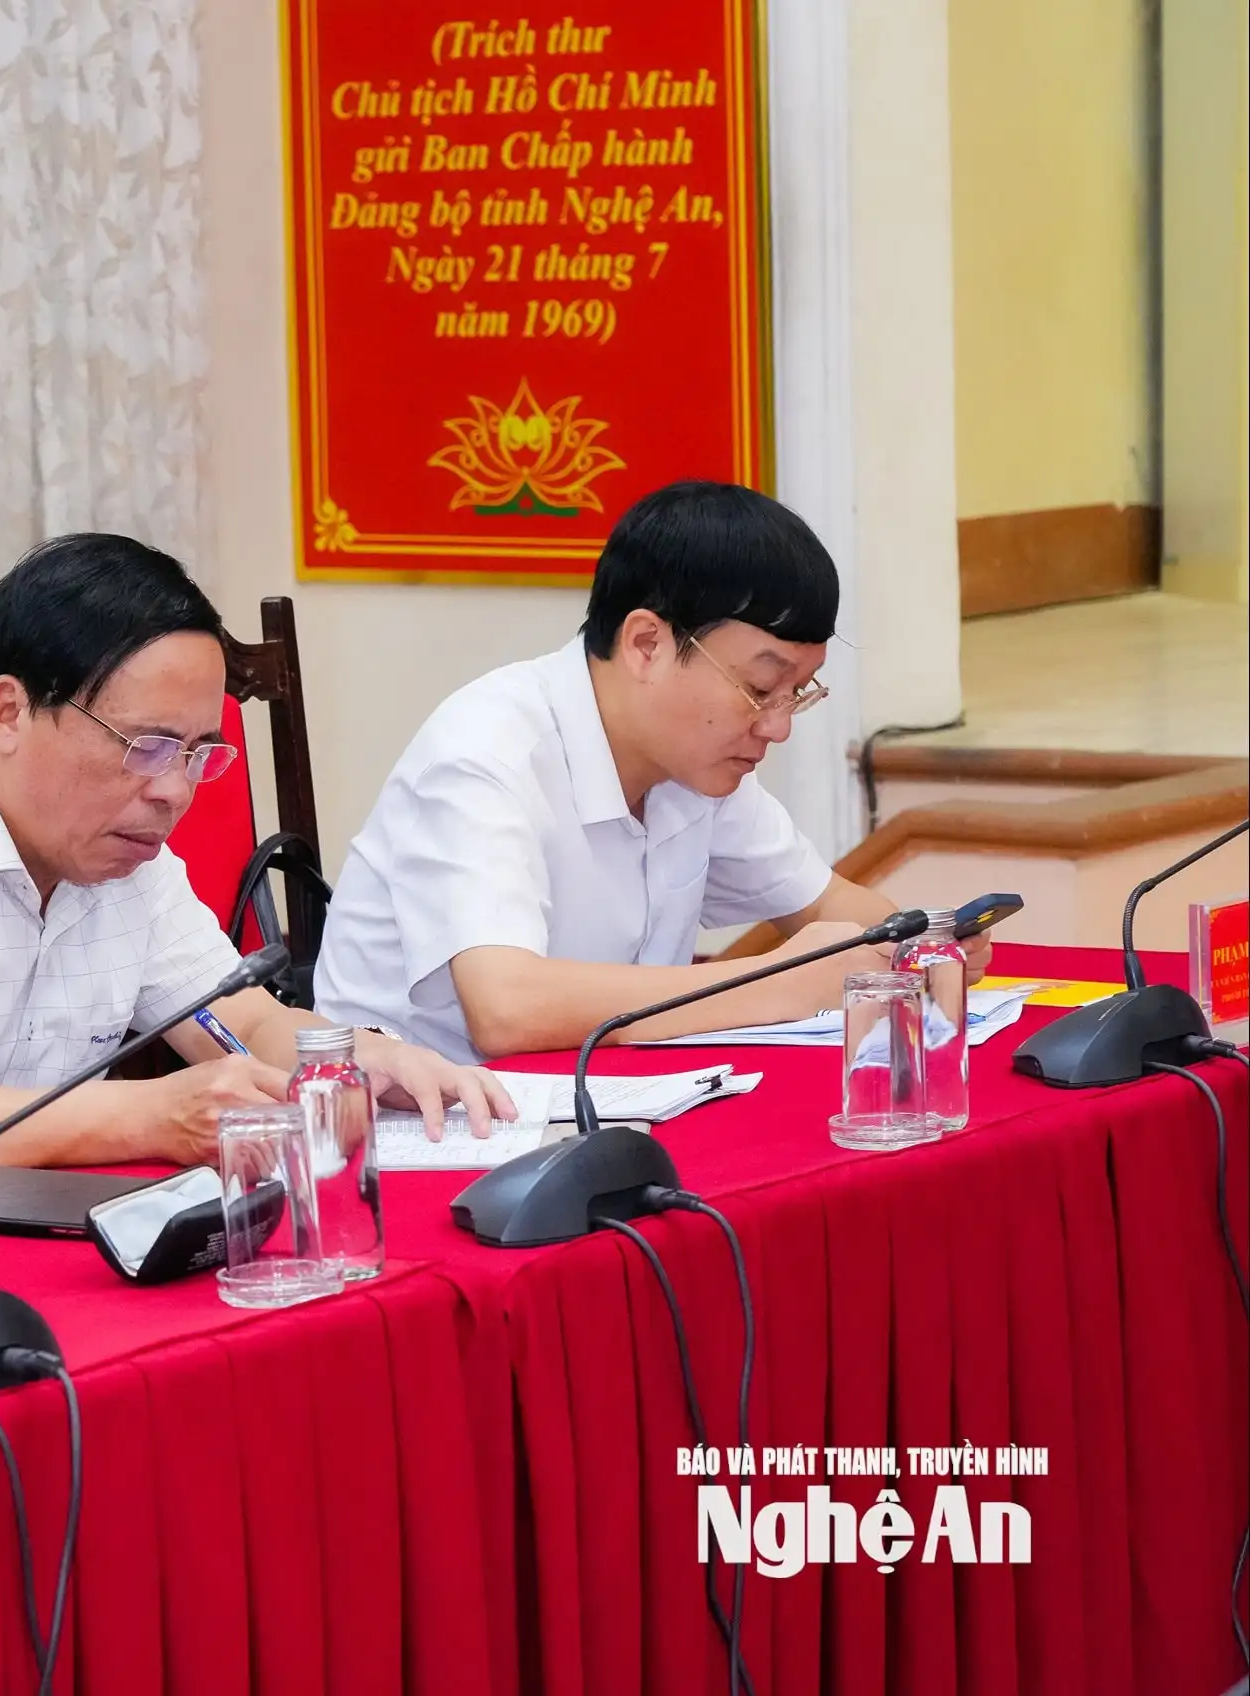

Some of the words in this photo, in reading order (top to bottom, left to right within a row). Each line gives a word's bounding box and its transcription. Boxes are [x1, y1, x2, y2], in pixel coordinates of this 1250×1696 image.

[432, 19, 536, 65] (Trích
[547, 17, 611, 55] thư
[332, 81, 401, 119] Chủ
[411, 77, 474, 126] tịch
[485, 64, 537, 114] Hồ
[548, 71, 613, 112] Chí
[620, 68, 717, 109] Minh
[352, 136, 411, 183] gửi
[421, 135, 489, 171] Ban
[501, 119, 593, 178] Chấp
[602, 127, 693, 166] hành
[330, 192, 421, 238] Đảng
[430, 189, 471, 236] bộ
[480, 188, 548, 226] tỉnh
[560, 185, 654, 234] Nghệ
[660, 186, 723, 227] An,
[385, 245, 475, 292] Ngày
[484, 245, 522, 281] 21
[534, 243, 635, 290] tháng
[649, 242, 669, 278] 7
[435, 303, 509, 337] năm
[523, 299, 616, 344] 1969)
[1213, 942, 1249, 967] PHẠM
